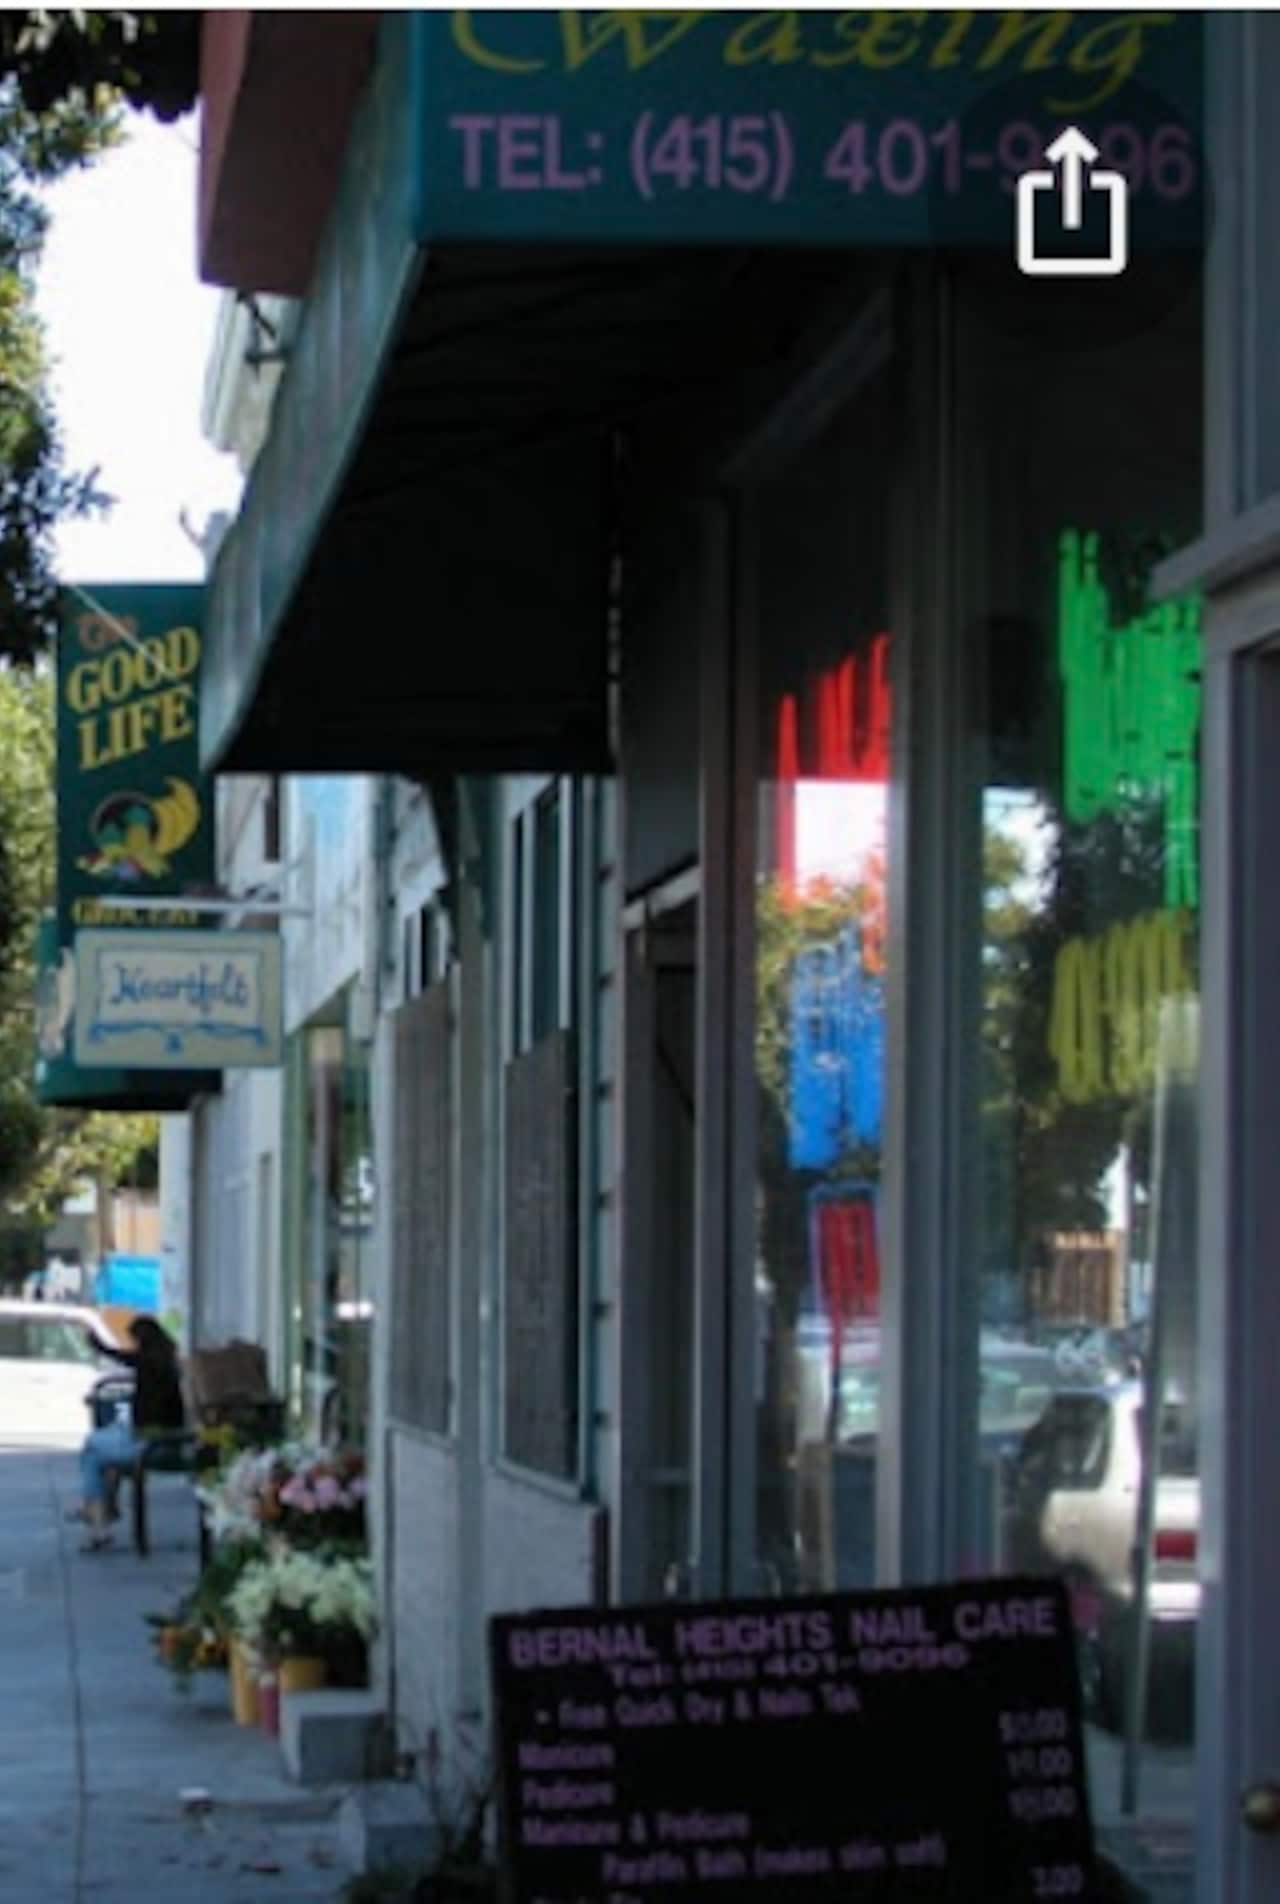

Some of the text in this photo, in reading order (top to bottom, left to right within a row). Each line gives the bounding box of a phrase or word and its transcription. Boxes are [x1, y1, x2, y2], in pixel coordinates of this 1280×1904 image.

[450, 111, 1198, 201] TEL: (415) 401-996
[67, 627, 200, 714] GOOD
[79, 686, 194, 771] LIFE
[511, 1599, 1058, 1665] BERNAL HEIGHTS NAIL CARE
